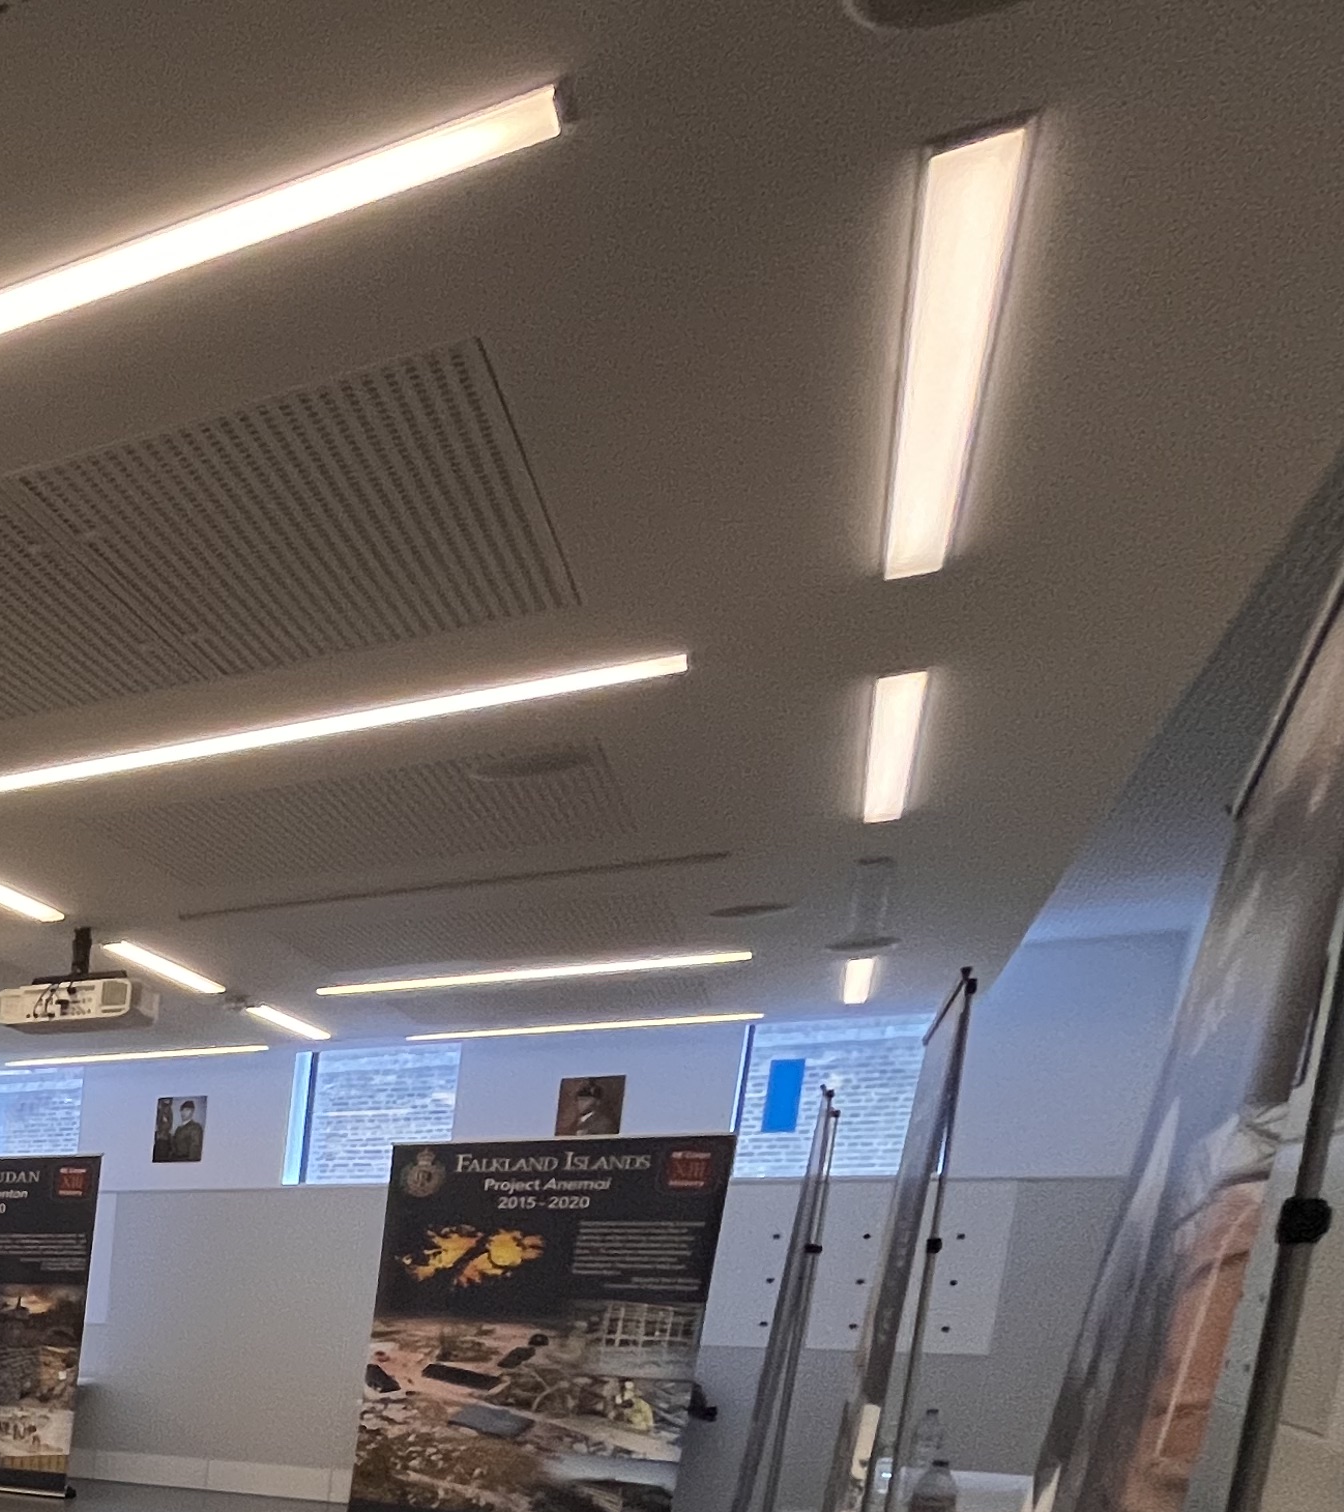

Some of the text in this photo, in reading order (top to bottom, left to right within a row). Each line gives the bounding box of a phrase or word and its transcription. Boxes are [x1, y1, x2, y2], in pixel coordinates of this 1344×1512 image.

[455, 1151, 652, 1173] FALKLAND ISLANDS
[484, 1177, 540, 1194] Project
